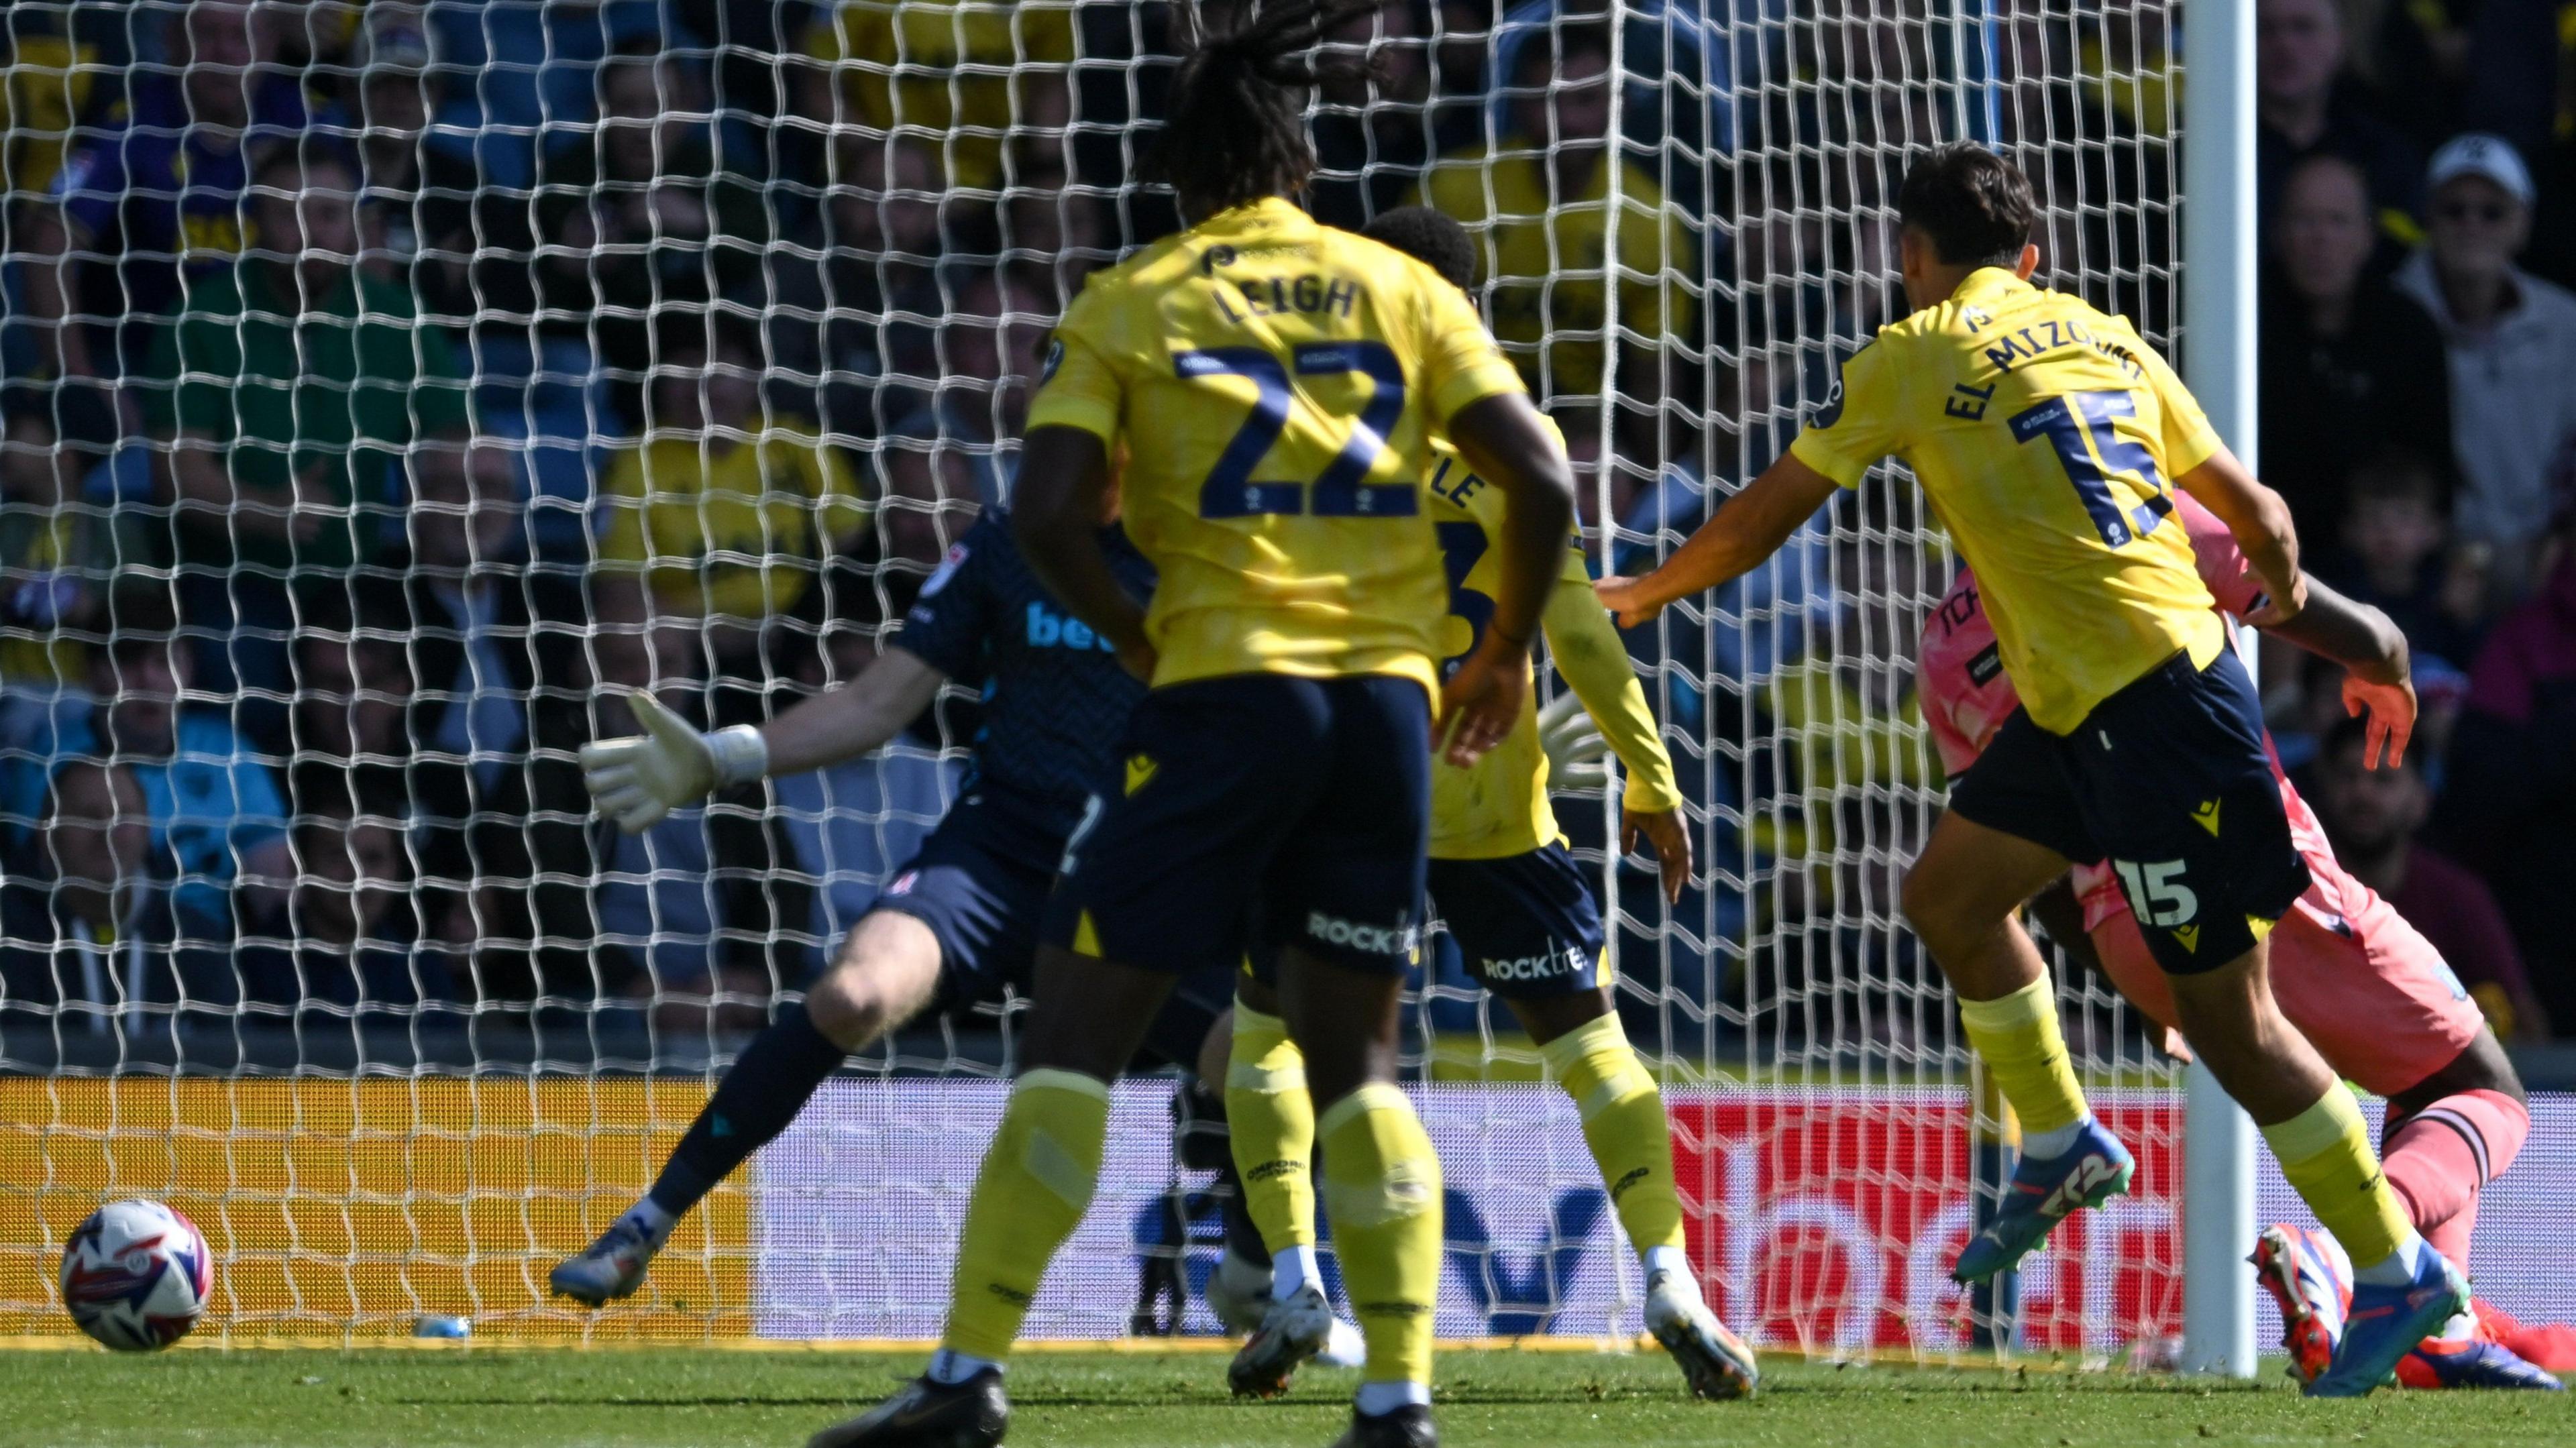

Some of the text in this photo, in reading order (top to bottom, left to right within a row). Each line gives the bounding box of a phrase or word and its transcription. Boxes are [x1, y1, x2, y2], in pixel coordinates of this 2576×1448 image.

[1211, 274, 1357, 324] LEIGH
[1171, 341, 1419, 519] 22
[1945, 382, 1996, 421] EL
[1429, 448, 1485, 508] LE
[2006, 390, 2174, 549] 15
[2114, 858, 2198, 927] 15
